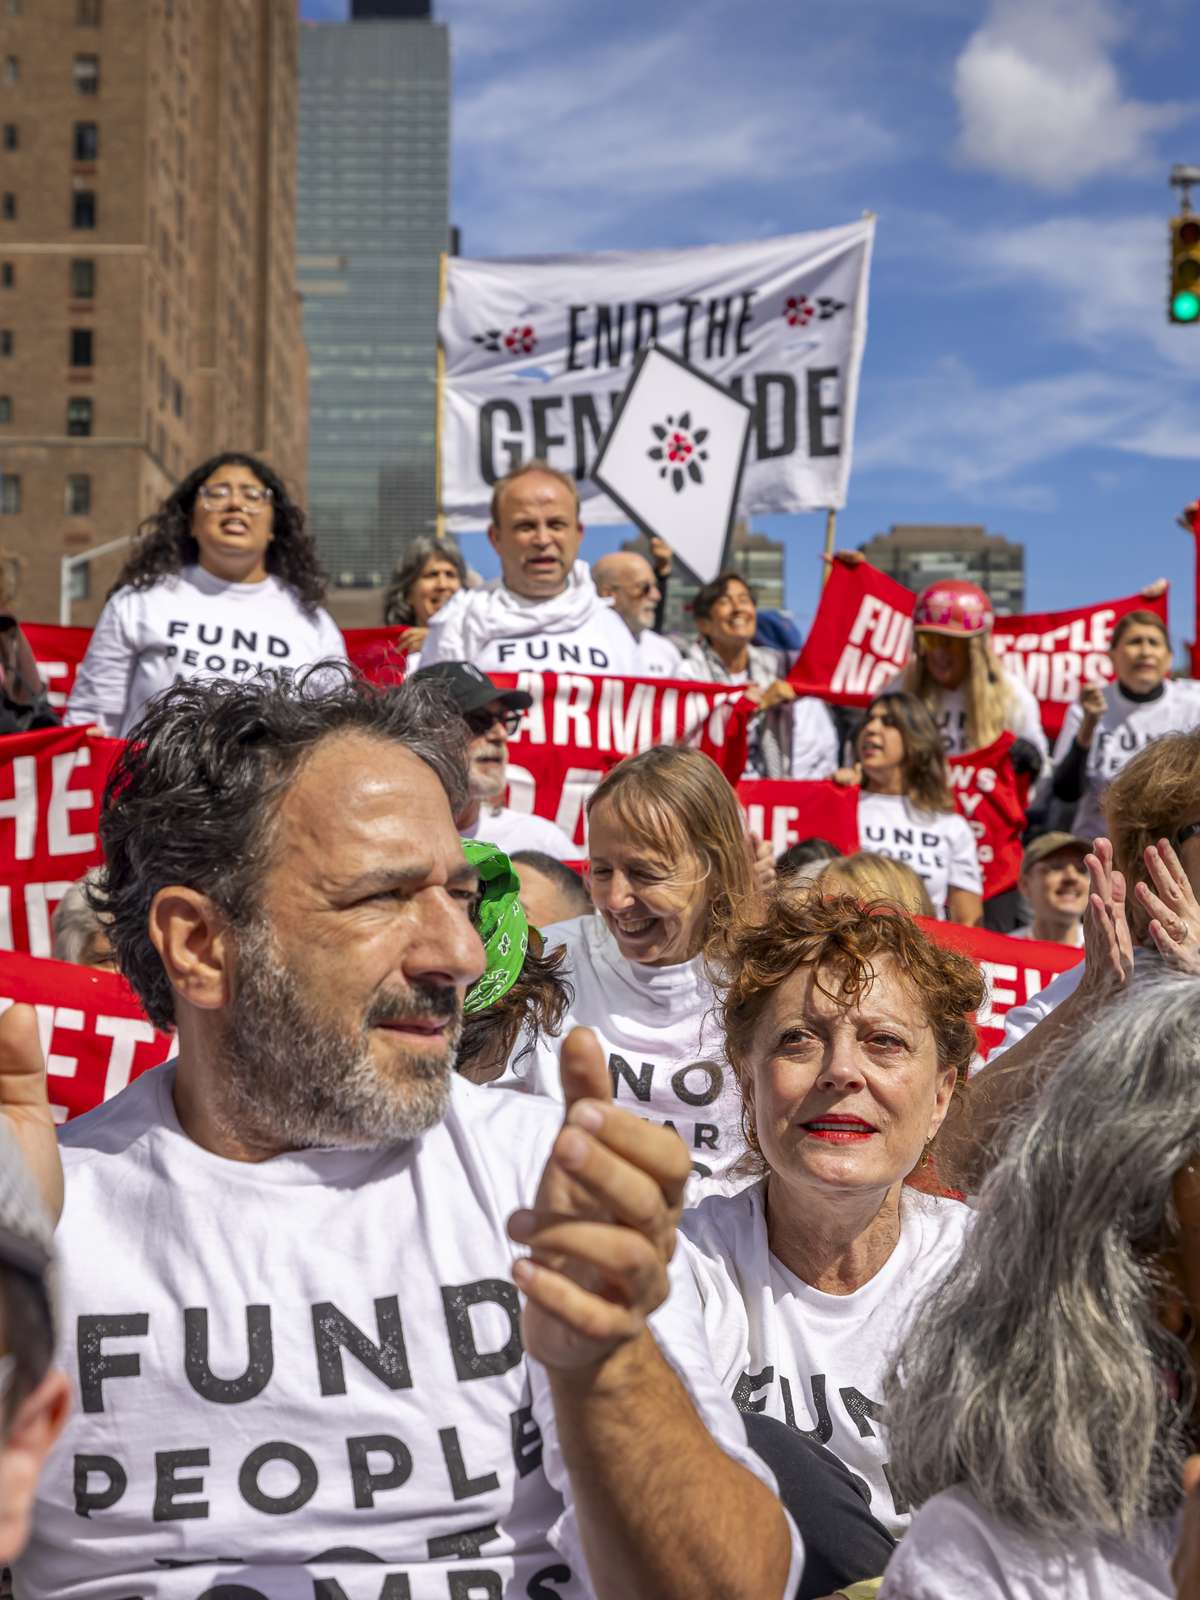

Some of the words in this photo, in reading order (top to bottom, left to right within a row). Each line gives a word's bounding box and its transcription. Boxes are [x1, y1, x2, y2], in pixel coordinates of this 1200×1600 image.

[567, 302, 659, 370] END
[677, 291, 758, 364] THE
[479, 367, 842, 487] GENDE
[167, 620, 291, 658] FUND
[498, 640, 609, 669] FUND
[848, 593, 914, 665] FU
[830, 643, 900, 695] NO
[1002, 651, 1115, 703] MBS
[503, 671, 744, 756] ARMIN
[865, 825, 941, 848] UND
[609, 1053, 724, 1107] NO
[77, 1278, 524, 1414] FUND
[731, 1365, 888, 1445] FUN
[73, 1406, 544, 1521] PEOPLE
